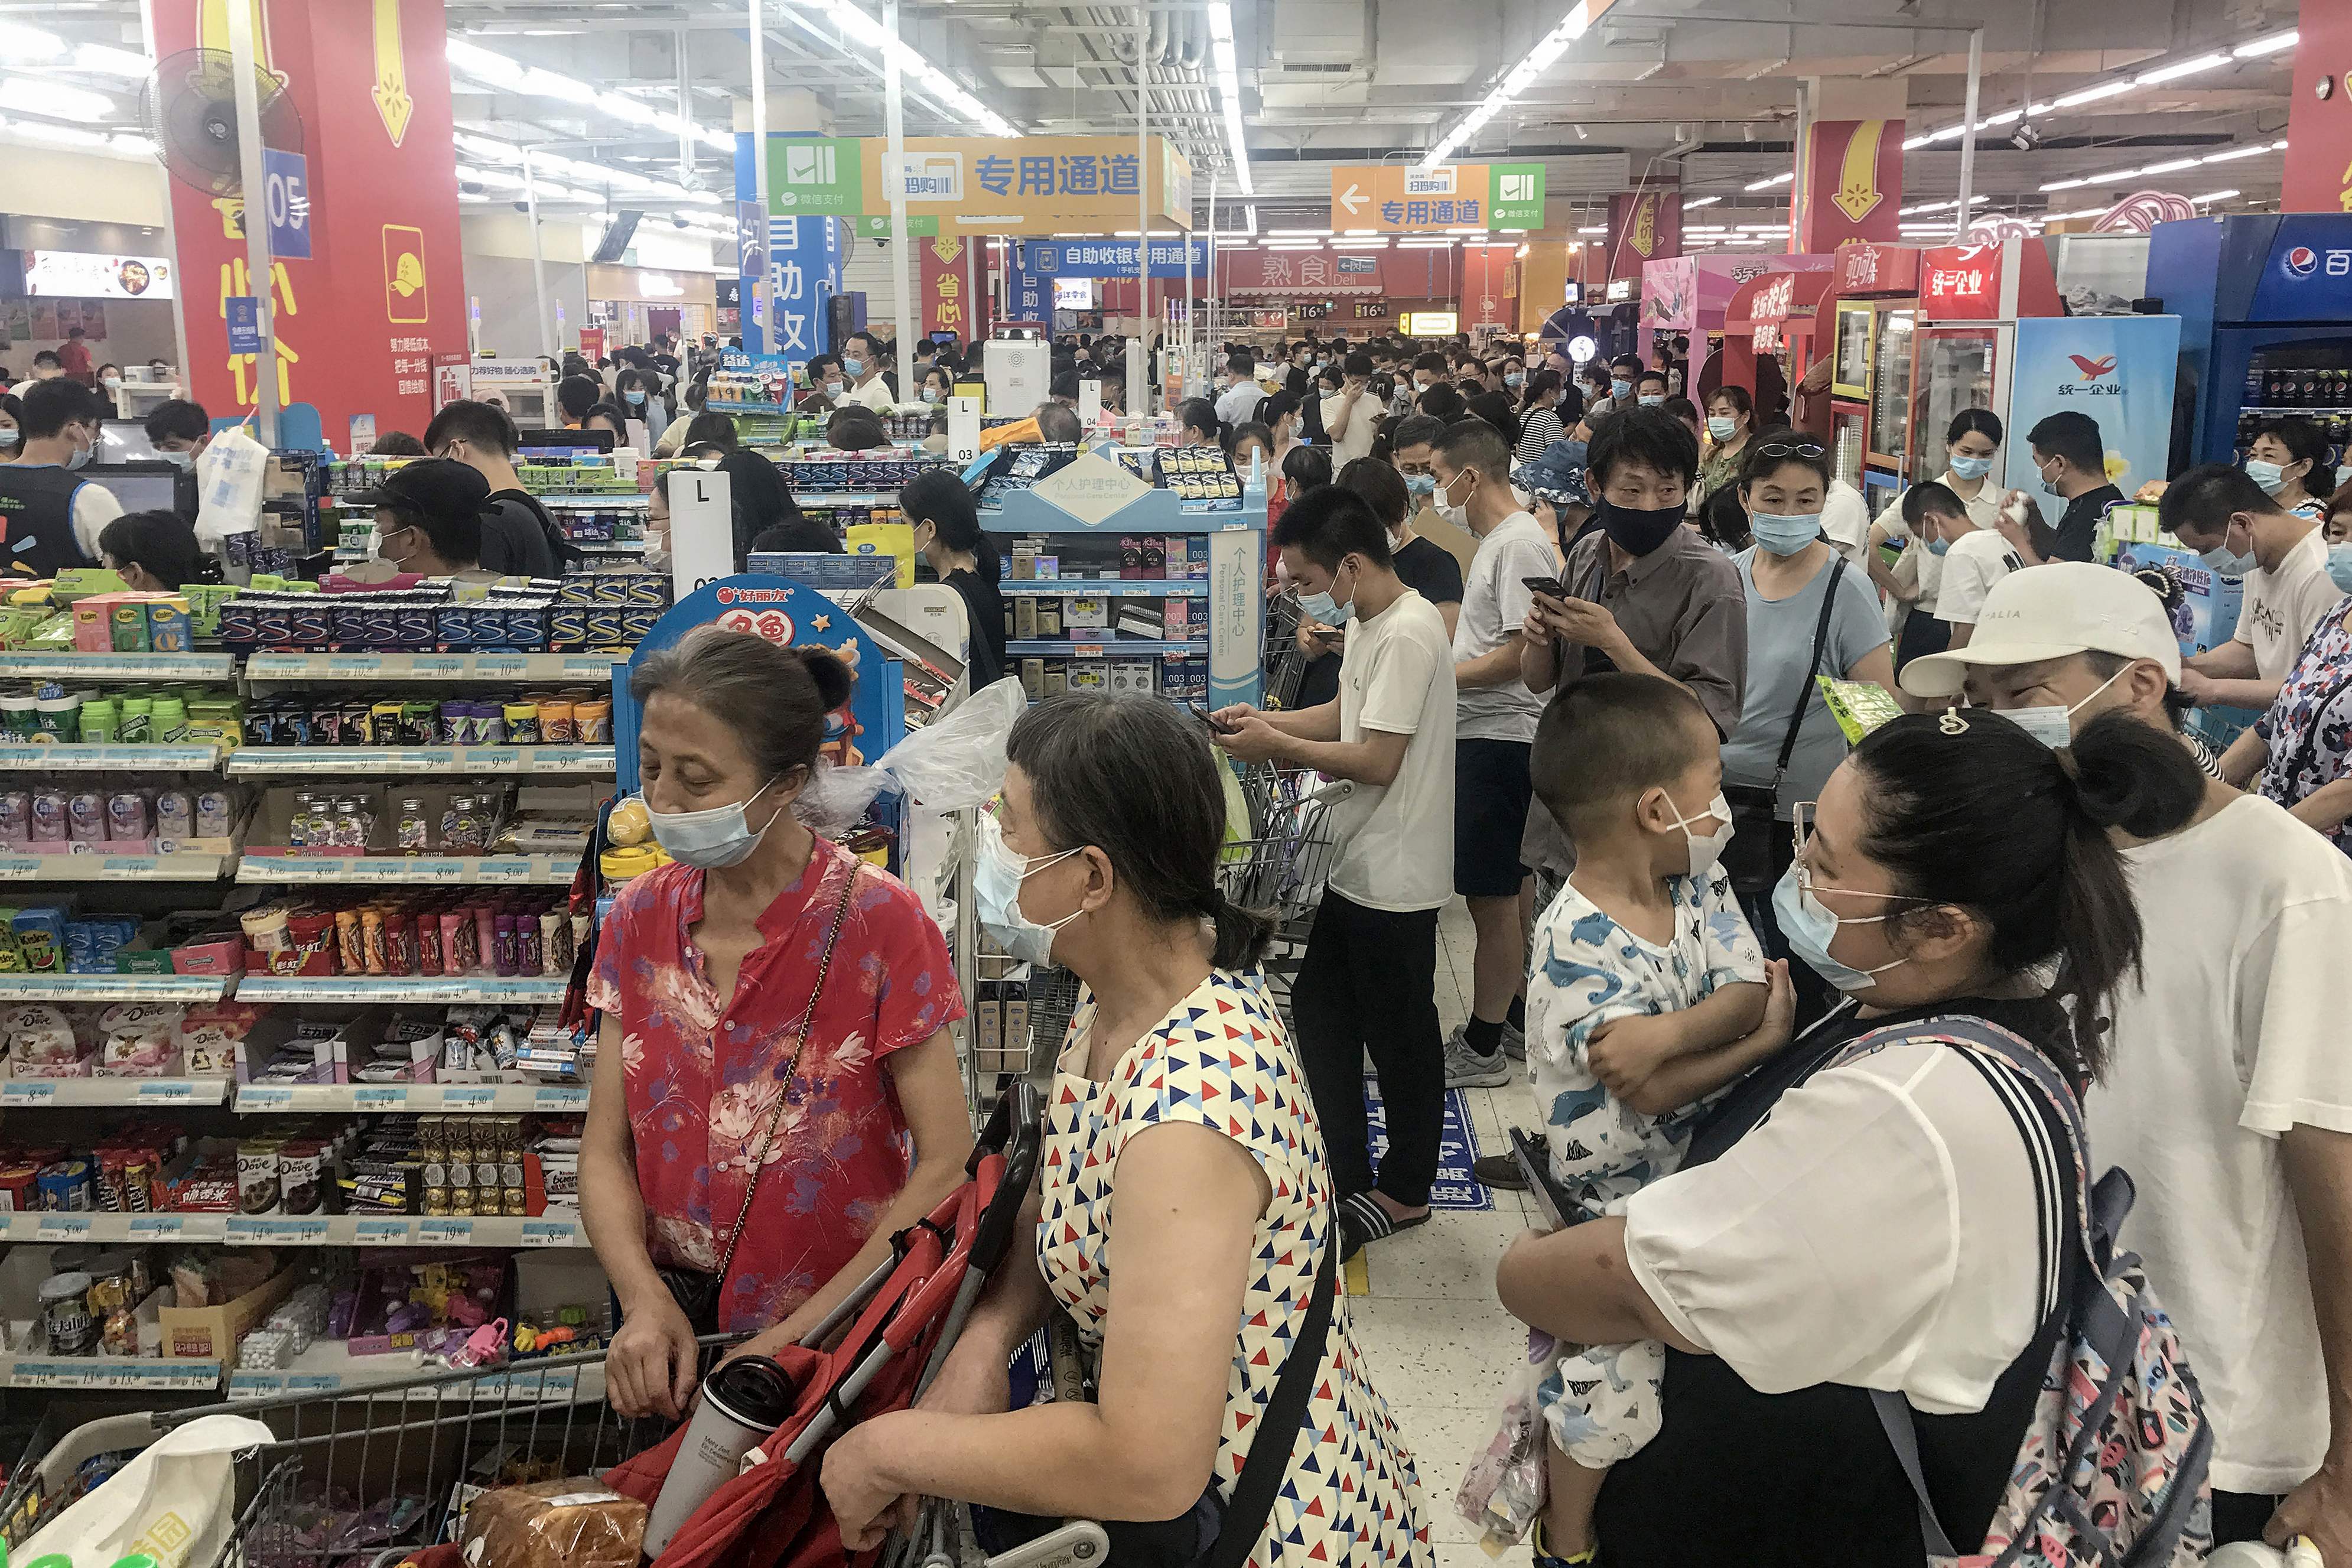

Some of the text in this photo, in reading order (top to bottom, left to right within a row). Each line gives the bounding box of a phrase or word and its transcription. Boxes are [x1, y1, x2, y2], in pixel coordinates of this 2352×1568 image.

[975, 154, 1140, 196] 专用通道
[895, 177, 937, 194] 玛购
[268, 173, 305, 230] 05
[800, 193, 844, 206] 微信支付
[1380, 200, 1480, 225] 专用通道
[1508, 209, 1539, 218] 微信支付
[887, 219, 924, 229] 支付
[2325, 249, 2352, 276] 百
[1262, 255, 1329, 286] 熟食
[1333, 274, 1357, 285] Deli
[395, 359, 427, 374] 把每一分钱
[723, 354, 751, 367] 益达
[505, 366, 536, 375] 随心选购
[1090, 383, 1095, 391] L
[2058, 383, 2122, 396] 统一企业
[962, 401, 968, 412] L
[958, 450, 973, 460] 03
[697, 480, 710, 502] L
[1053, 477, 1131, 492] 个人护理中心
[1192, 550, 1208, 559] 003
[739, 589, 789, 603] 好丽友
[1232, 547, 1247, 637] 个人护理中心
[1166, 612, 1182, 620] 003
[1192, 612, 1208, 620] 003
[437, 663, 457, 676] 10.90
[500, 664, 521, 676] 10.90
[1169, 675, 1185, 683] 003
[1190, 675, 1206, 683] 003
[426, 757, 445, 769] 9.90
[492, 756, 511, 768] 9.90
[559, 756, 578, 768] 9.90
[316, 865, 335, 879] 8.00
[378, 866, 396, 880] 8.00
[435, 867, 454, 880] 8.00
[505, 868, 523, 883] 5.00
[19, 1013, 53, 1027] Dove
[123, 1005, 165, 1022] Dove
[195, 1033, 222, 1044] Dove
[469, 1095, 487, 1108] 4.80
[562, 1095, 580, 1109] 7.90
[238, 1159, 271, 1172] Dove
[280, 1161, 313, 1175] Dove
[552, 1175, 577, 1185] buen
